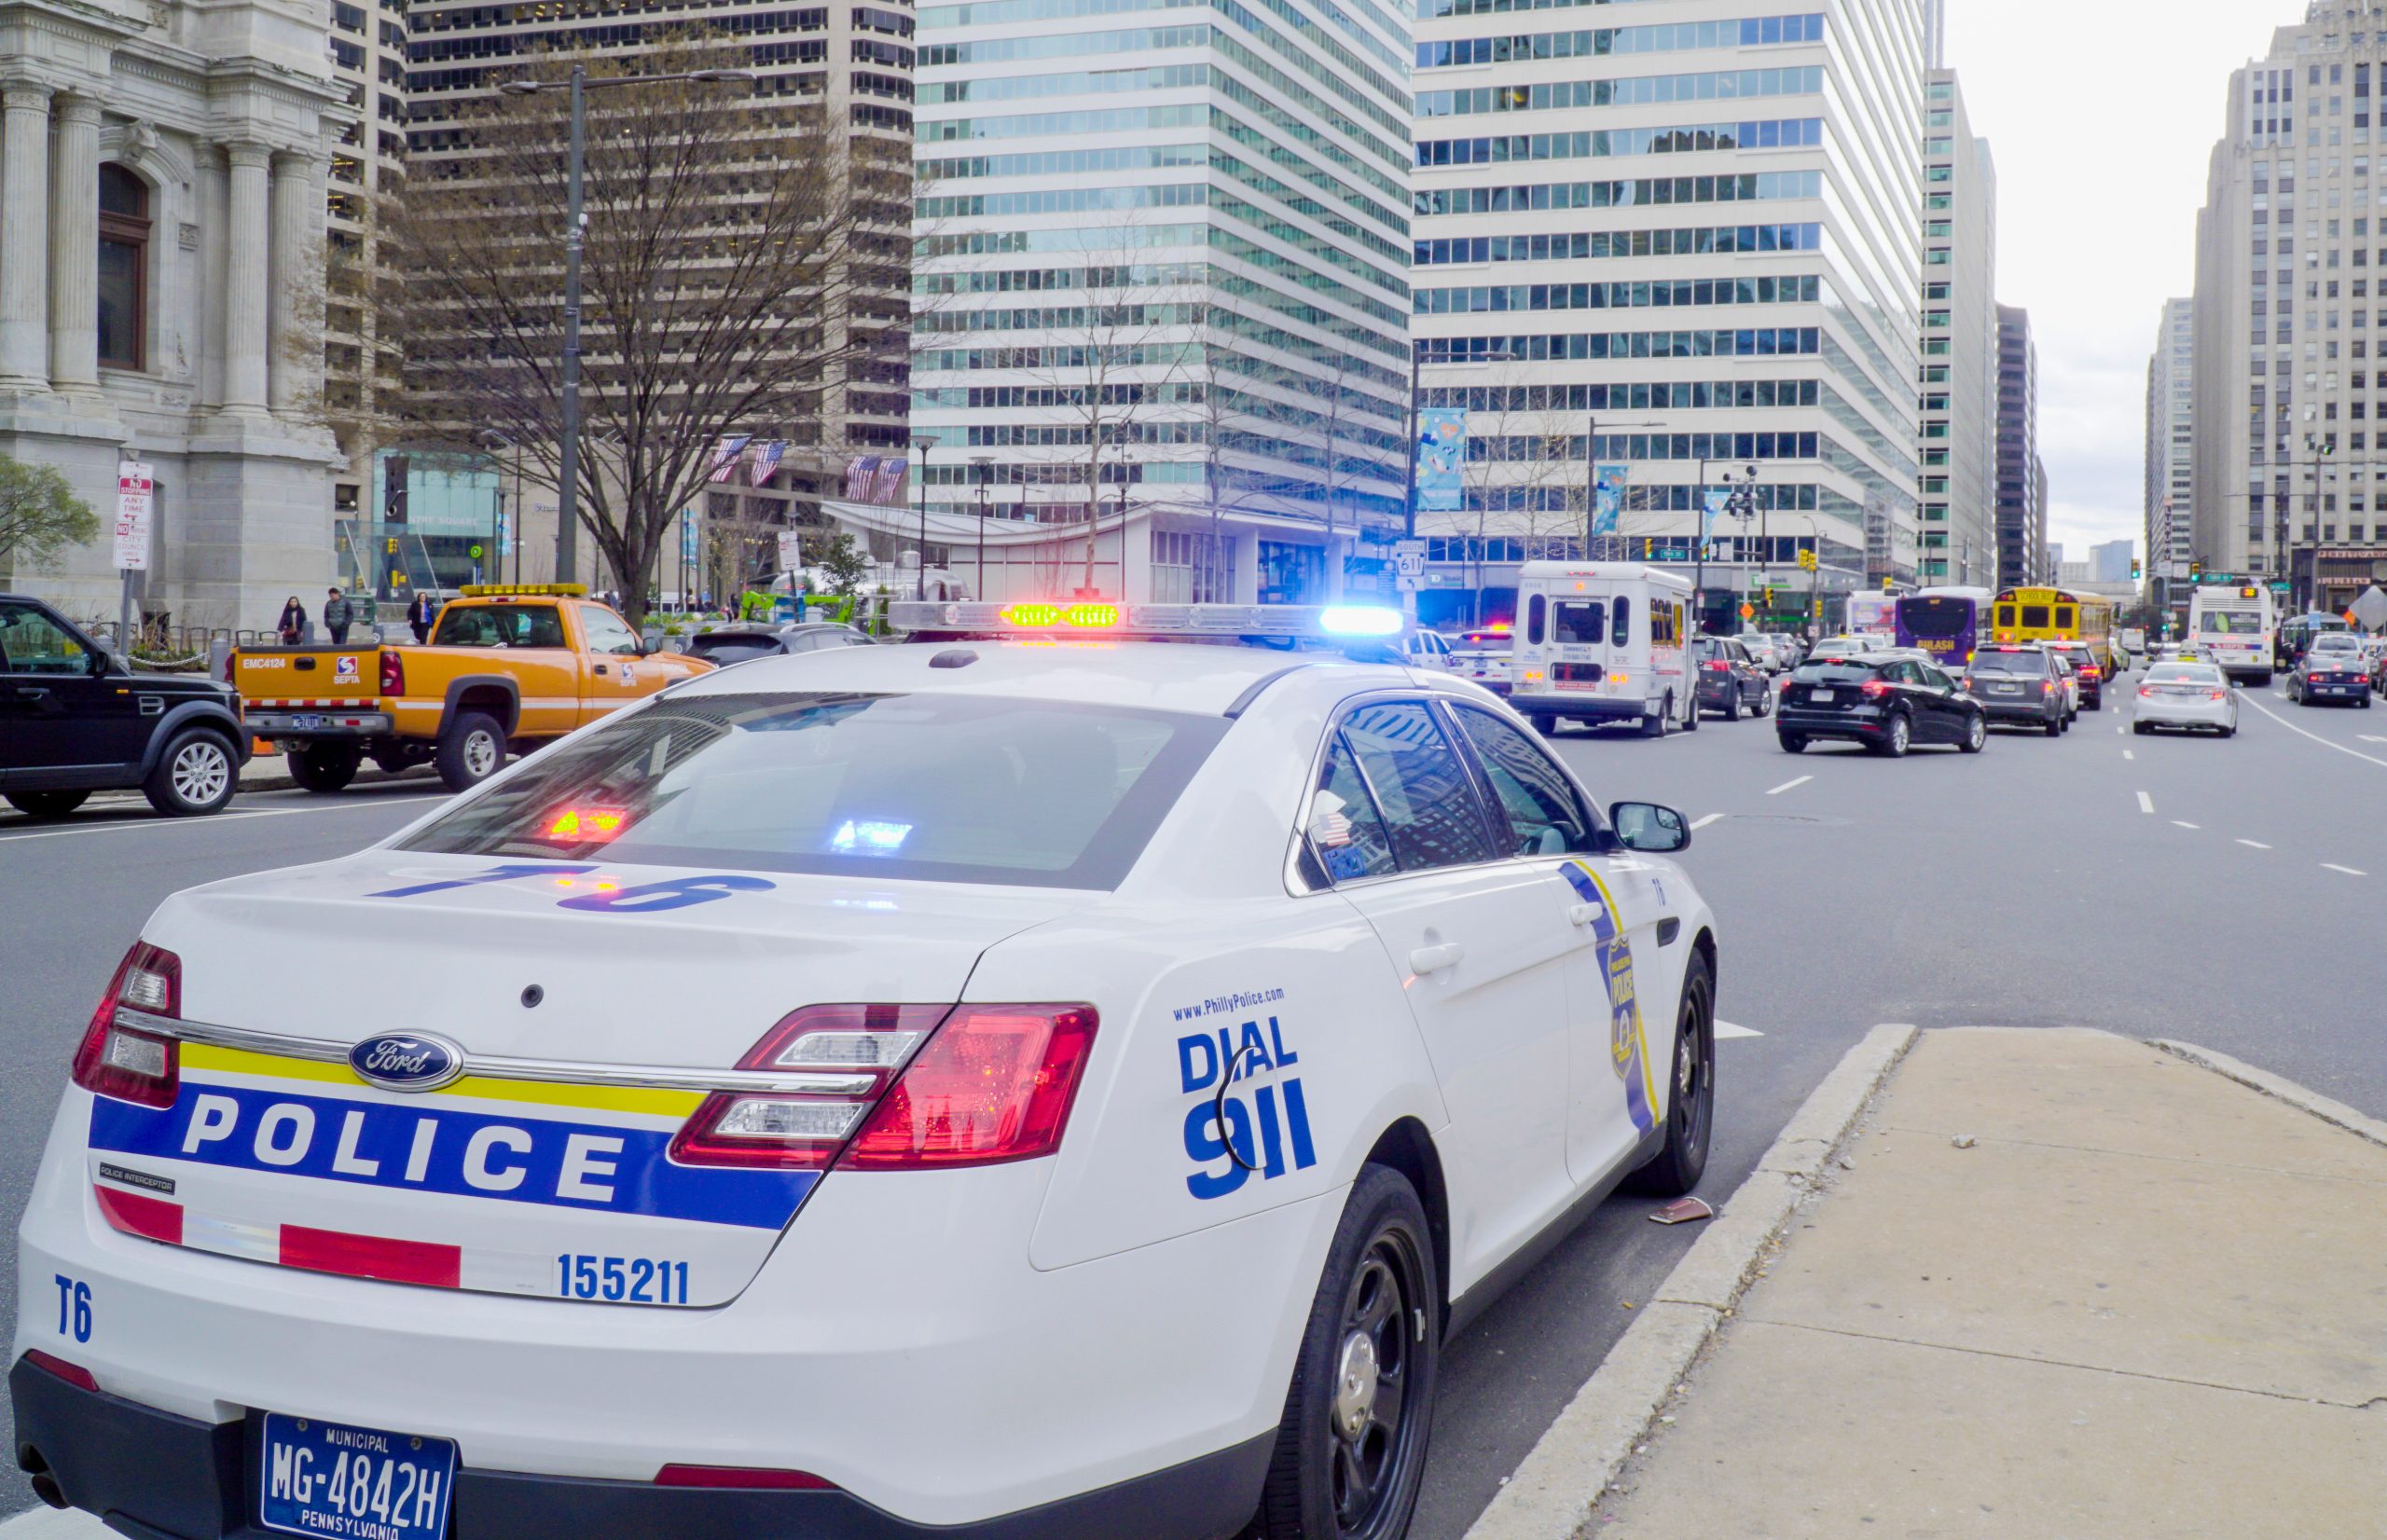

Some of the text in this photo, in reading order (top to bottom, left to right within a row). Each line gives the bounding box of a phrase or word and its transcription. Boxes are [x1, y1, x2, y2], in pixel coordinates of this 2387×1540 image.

[120, 488, 150, 496] STOPPING
[130, 478, 142, 488] NO
[123, 504, 145, 513] TIME
[437, 517, 478, 526] SQUARE
[117, 525, 129, 534] NO
[1401, 558, 1420, 571] 611
[243, 658, 285, 668] EMC4124
[334, 675, 360, 684] SEPTA
[1613, 968, 1634, 1009] POLICE
[1173, 988, 1285, 1022] www.PhillyPolice.com
[366, 1039, 431, 1073] Ford
[1178, 1015, 1298, 1094] DIAL
[182, 1093, 625, 1203] POLICE
[1183, 1077, 1317, 1201] 911
[101, 1166, 172, 1191] POLICE INTERCEPTOR
[558, 1254, 688, 1304] 155211
[55, 1273, 91, 1343] T6
[326, 1428, 389, 1453] MUNICIPAL
[271, 1442, 441, 1530] MG-4842H
[301, 1509, 399, 1540] PENNSYLVANIA
